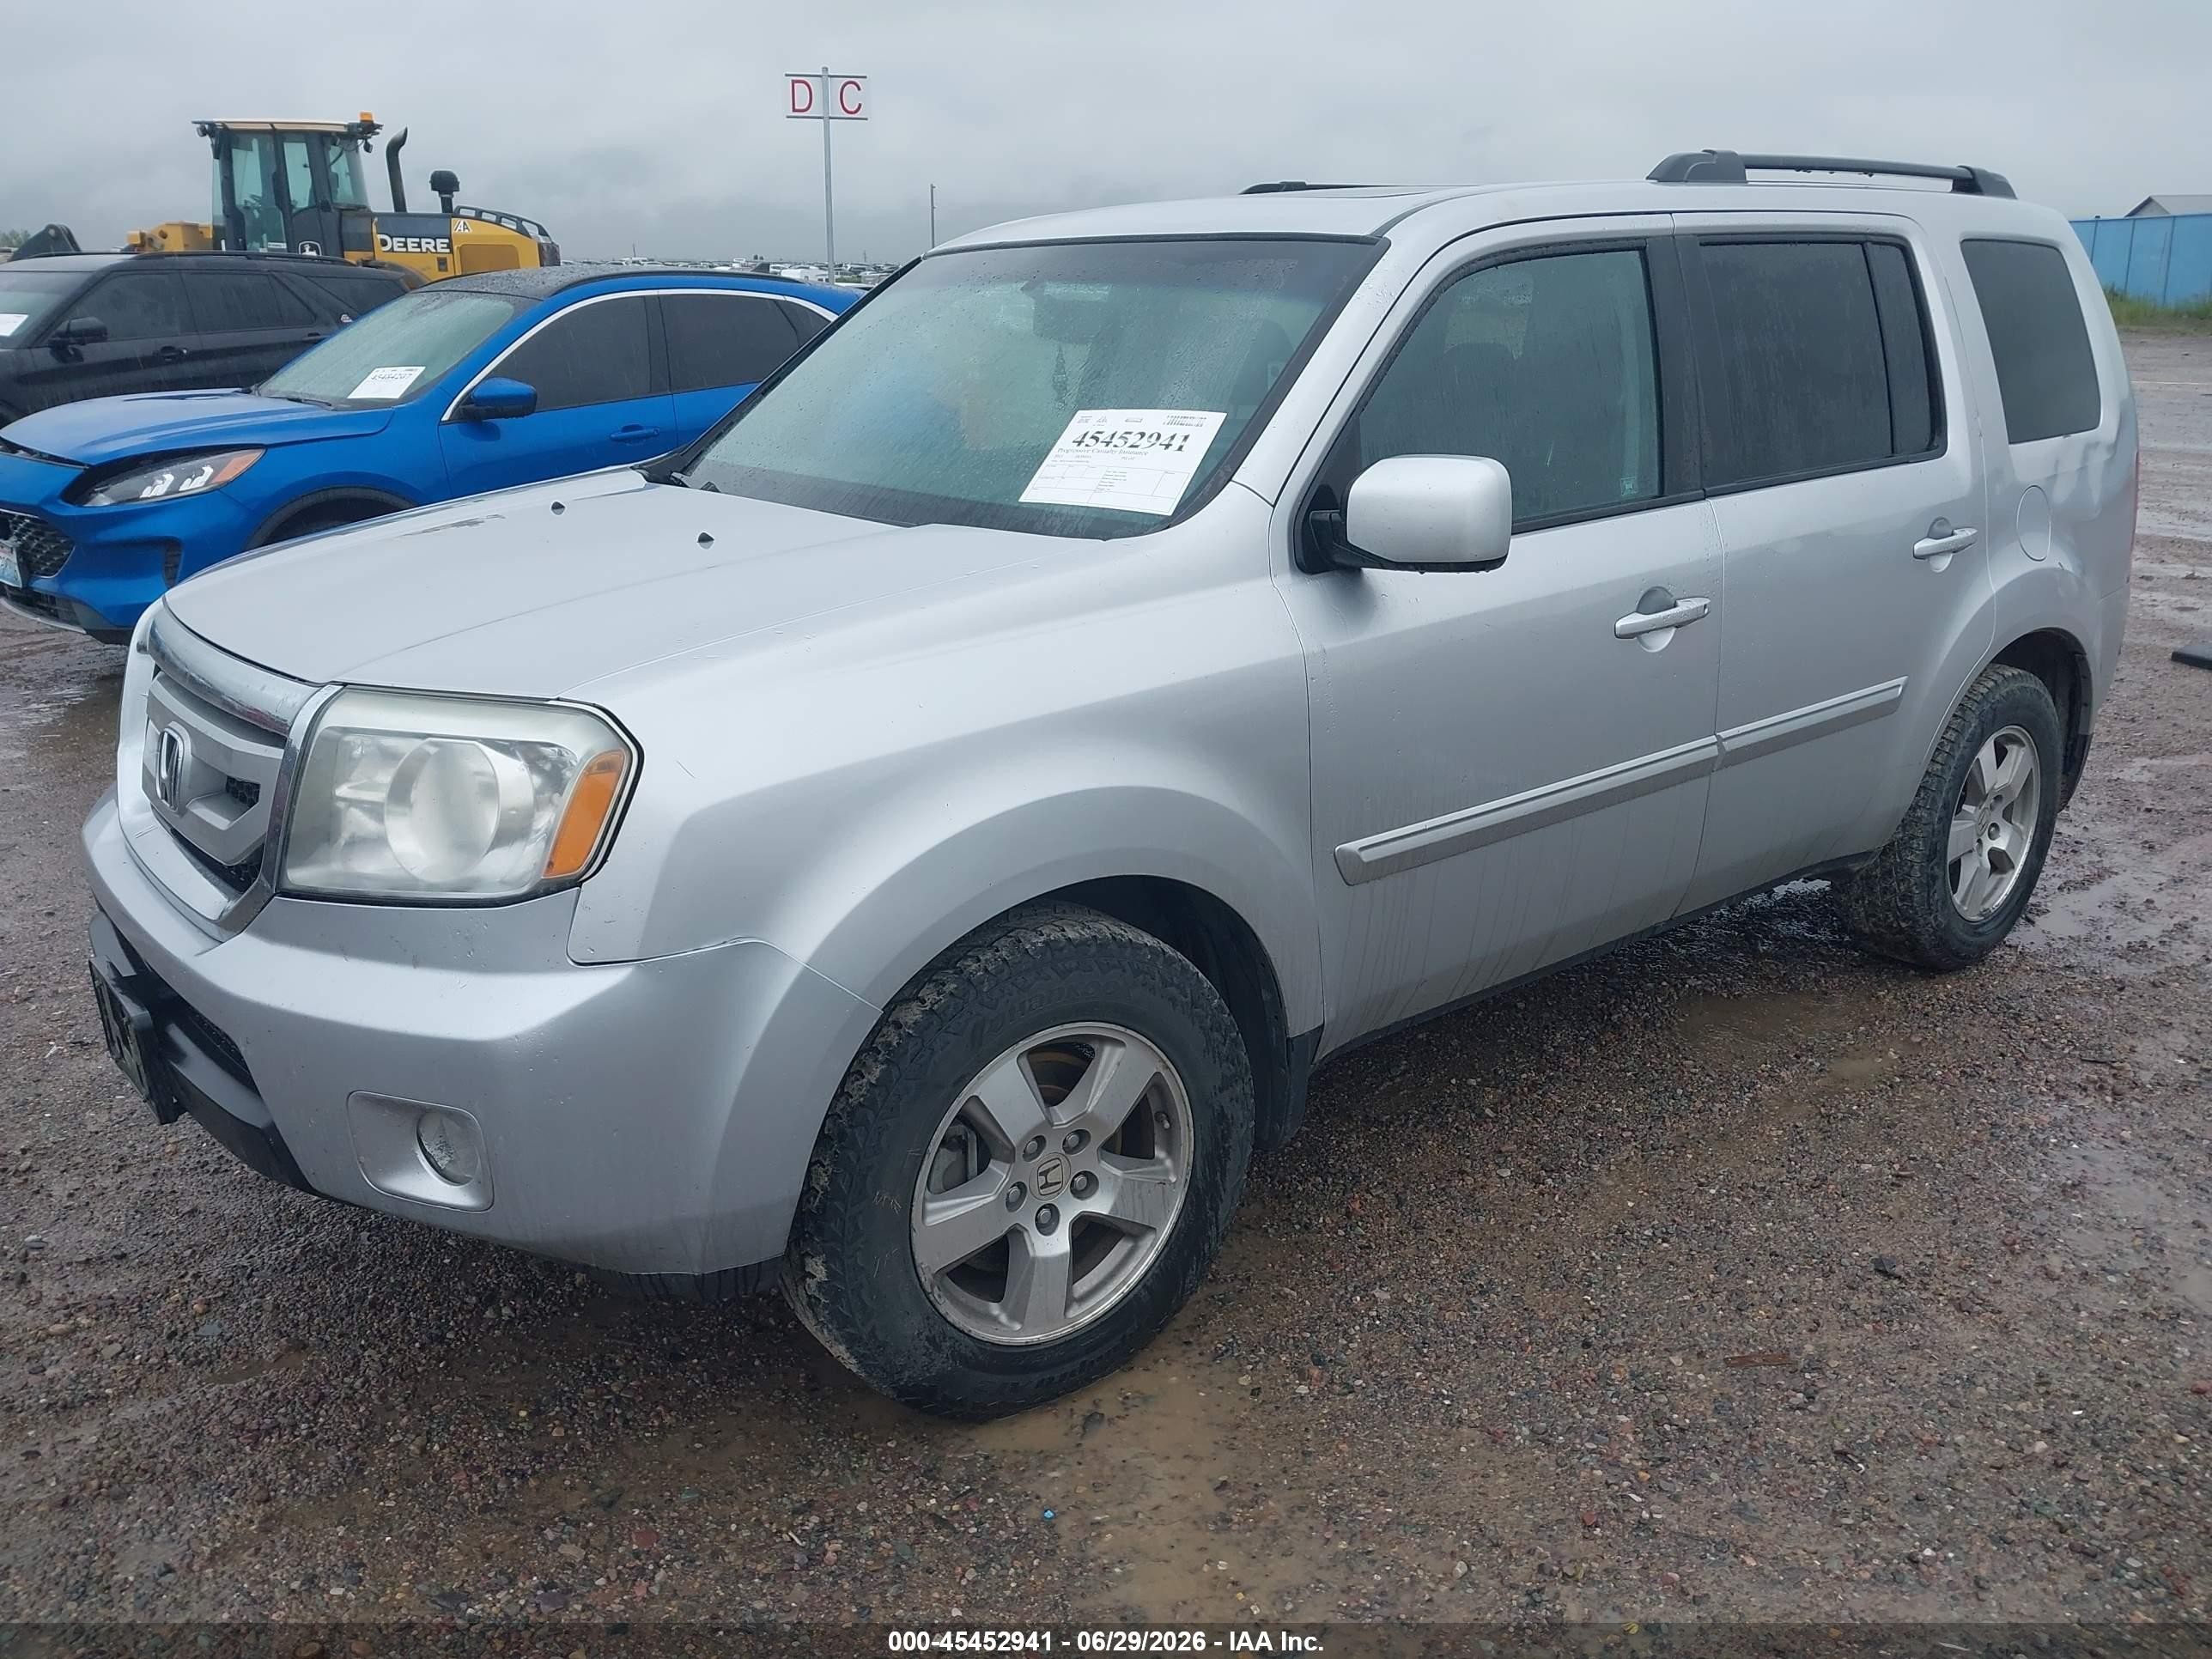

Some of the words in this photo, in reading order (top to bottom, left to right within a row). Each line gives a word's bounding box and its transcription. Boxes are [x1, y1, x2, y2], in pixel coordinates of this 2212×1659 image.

[791, 79, 813, 112] D
[840, 80, 862, 114] C
[376, 233, 451, 253] DEERE
[1072, 430, 1191, 452] 45452941
